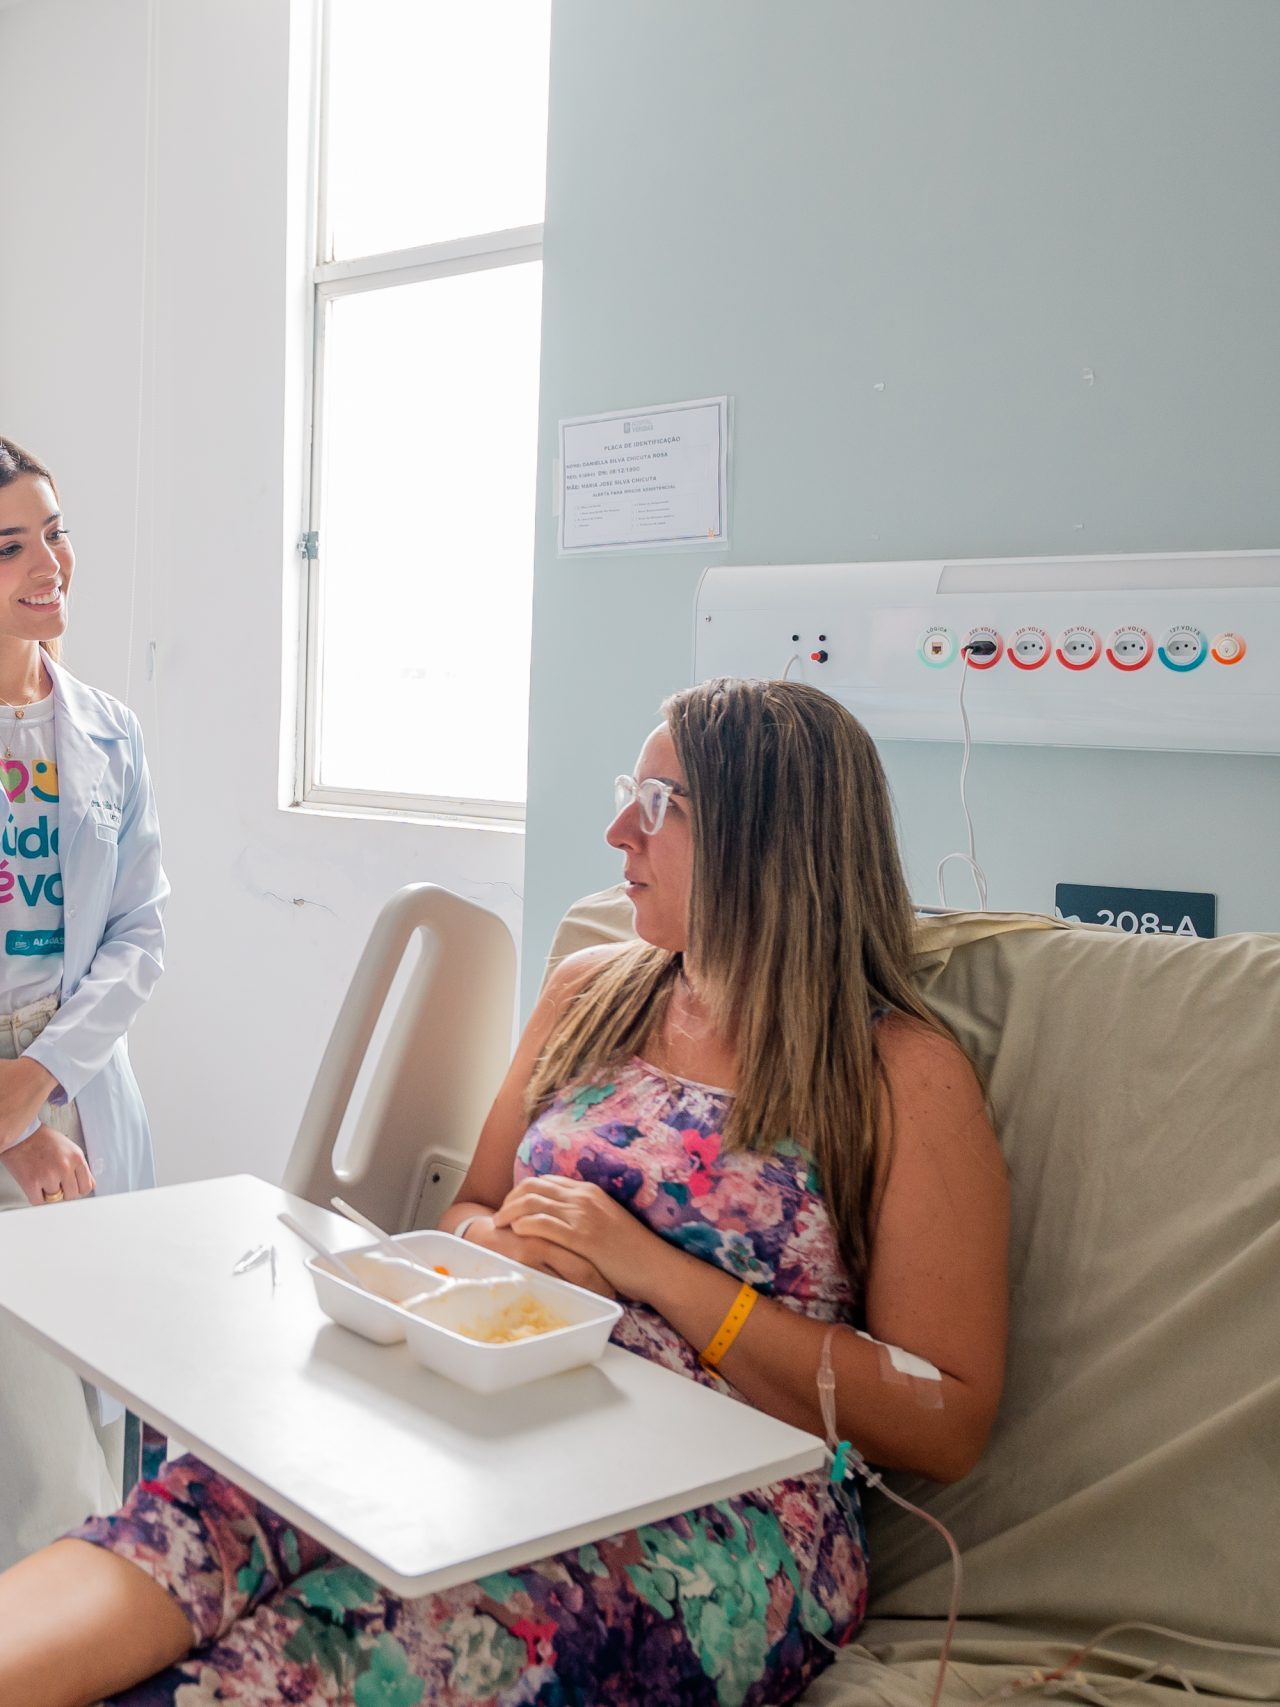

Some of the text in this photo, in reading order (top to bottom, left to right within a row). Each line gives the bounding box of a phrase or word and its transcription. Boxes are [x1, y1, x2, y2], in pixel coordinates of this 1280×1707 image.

[603, 443, 623, 451] PLACA
[633, 436, 681, 448] IDENTIFICAÇÃO
[980, 626, 998, 637] VOLTS
[1027, 626, 1046, 637] VOLTS
[1076, 626, 1095, 636] VOLTS
[1127, 625, 1148, 637] VOLTS
[1180, 625, 1201, 637] VOLTS
[1096, 909, 1199, 938] 208-A
